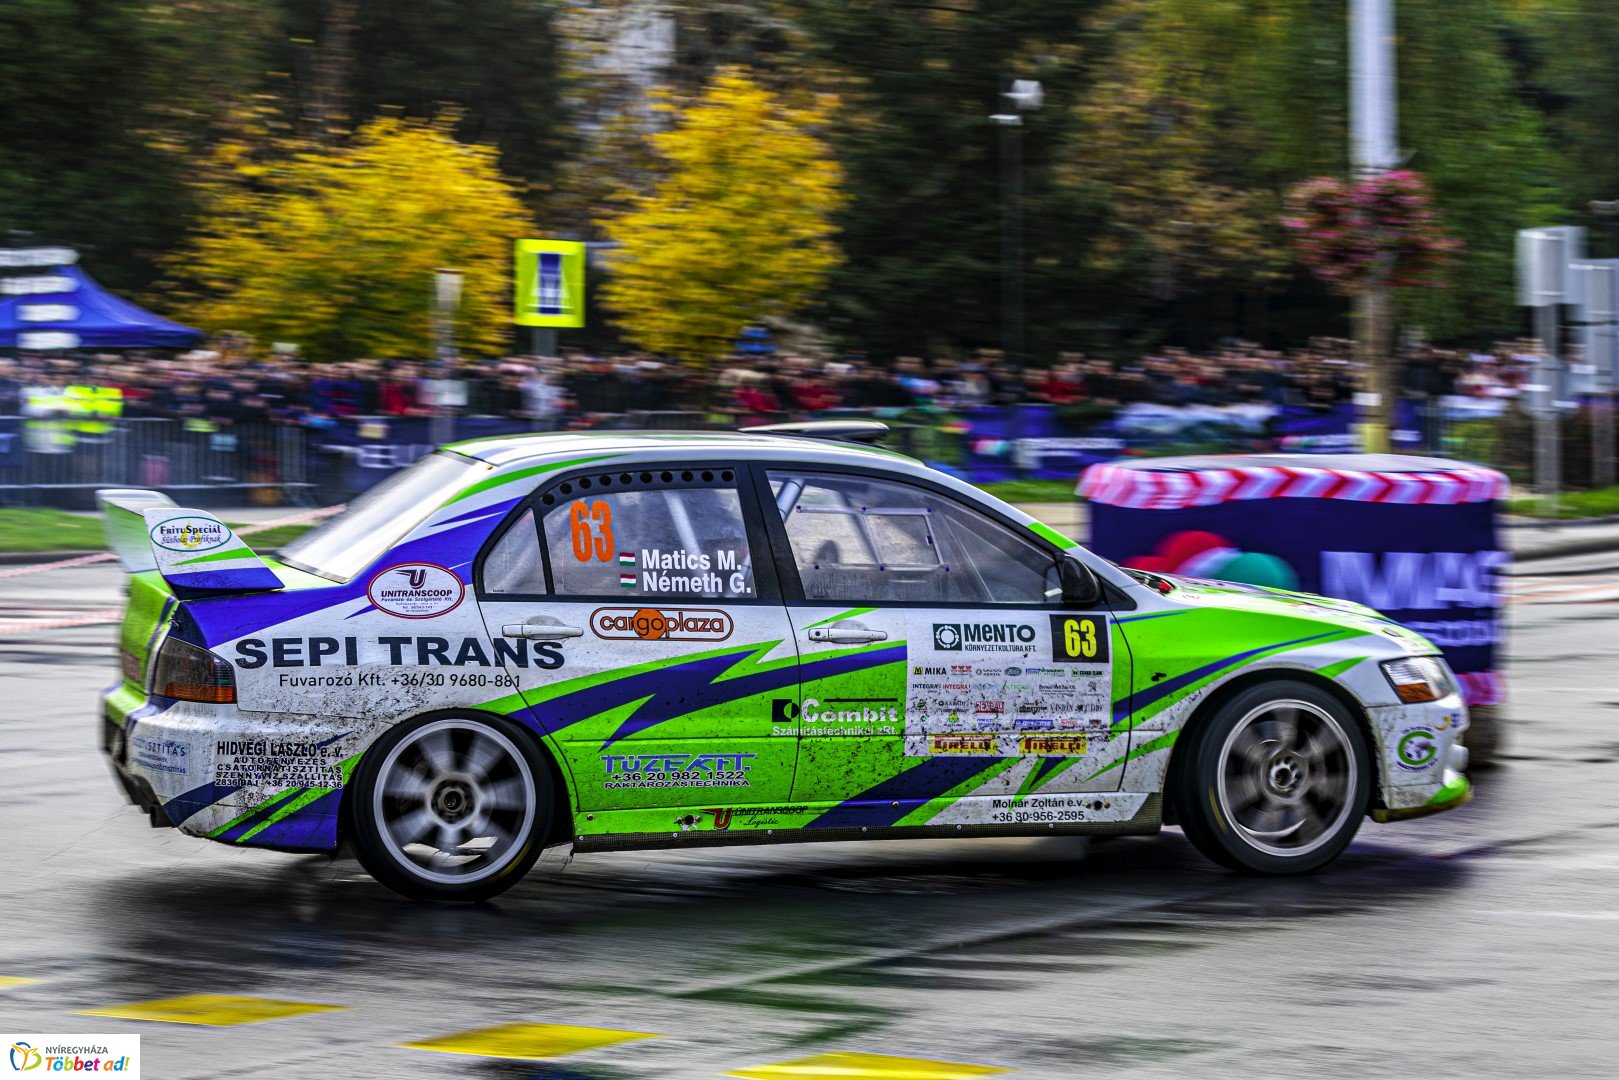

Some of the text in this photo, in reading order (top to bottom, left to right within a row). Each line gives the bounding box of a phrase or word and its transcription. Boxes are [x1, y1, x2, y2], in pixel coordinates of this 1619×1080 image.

[569, 500, 615, 563] 63
[642, 549, 742, 571] Matics M.
[643, 570, 752, 594] Németh G.
[381, 589, 453, 597] UNITRANSCOOP
[599, 611, 725, 639] cargoplaza
[1063, 619, 1097, 658] 63
[235, 637, 566, 669] SEPI TRANS
[279, 670, 520, 688] Fuvarozó Kft. +36/30 9680-881
[924, 667, 947, 676] MIKA
[801, 698, 898, 722] Combit
[215, 778, 238, 786] 2836
[240, 778, 259, 787] BAJ
[267, 779, 282, 787] +36
[611, 771, 745, 781] +36 20 982 1522
[1031, 798, 1065, 809] Zoltán
[992, 811, 1085, 821] +36 30-956-2595
